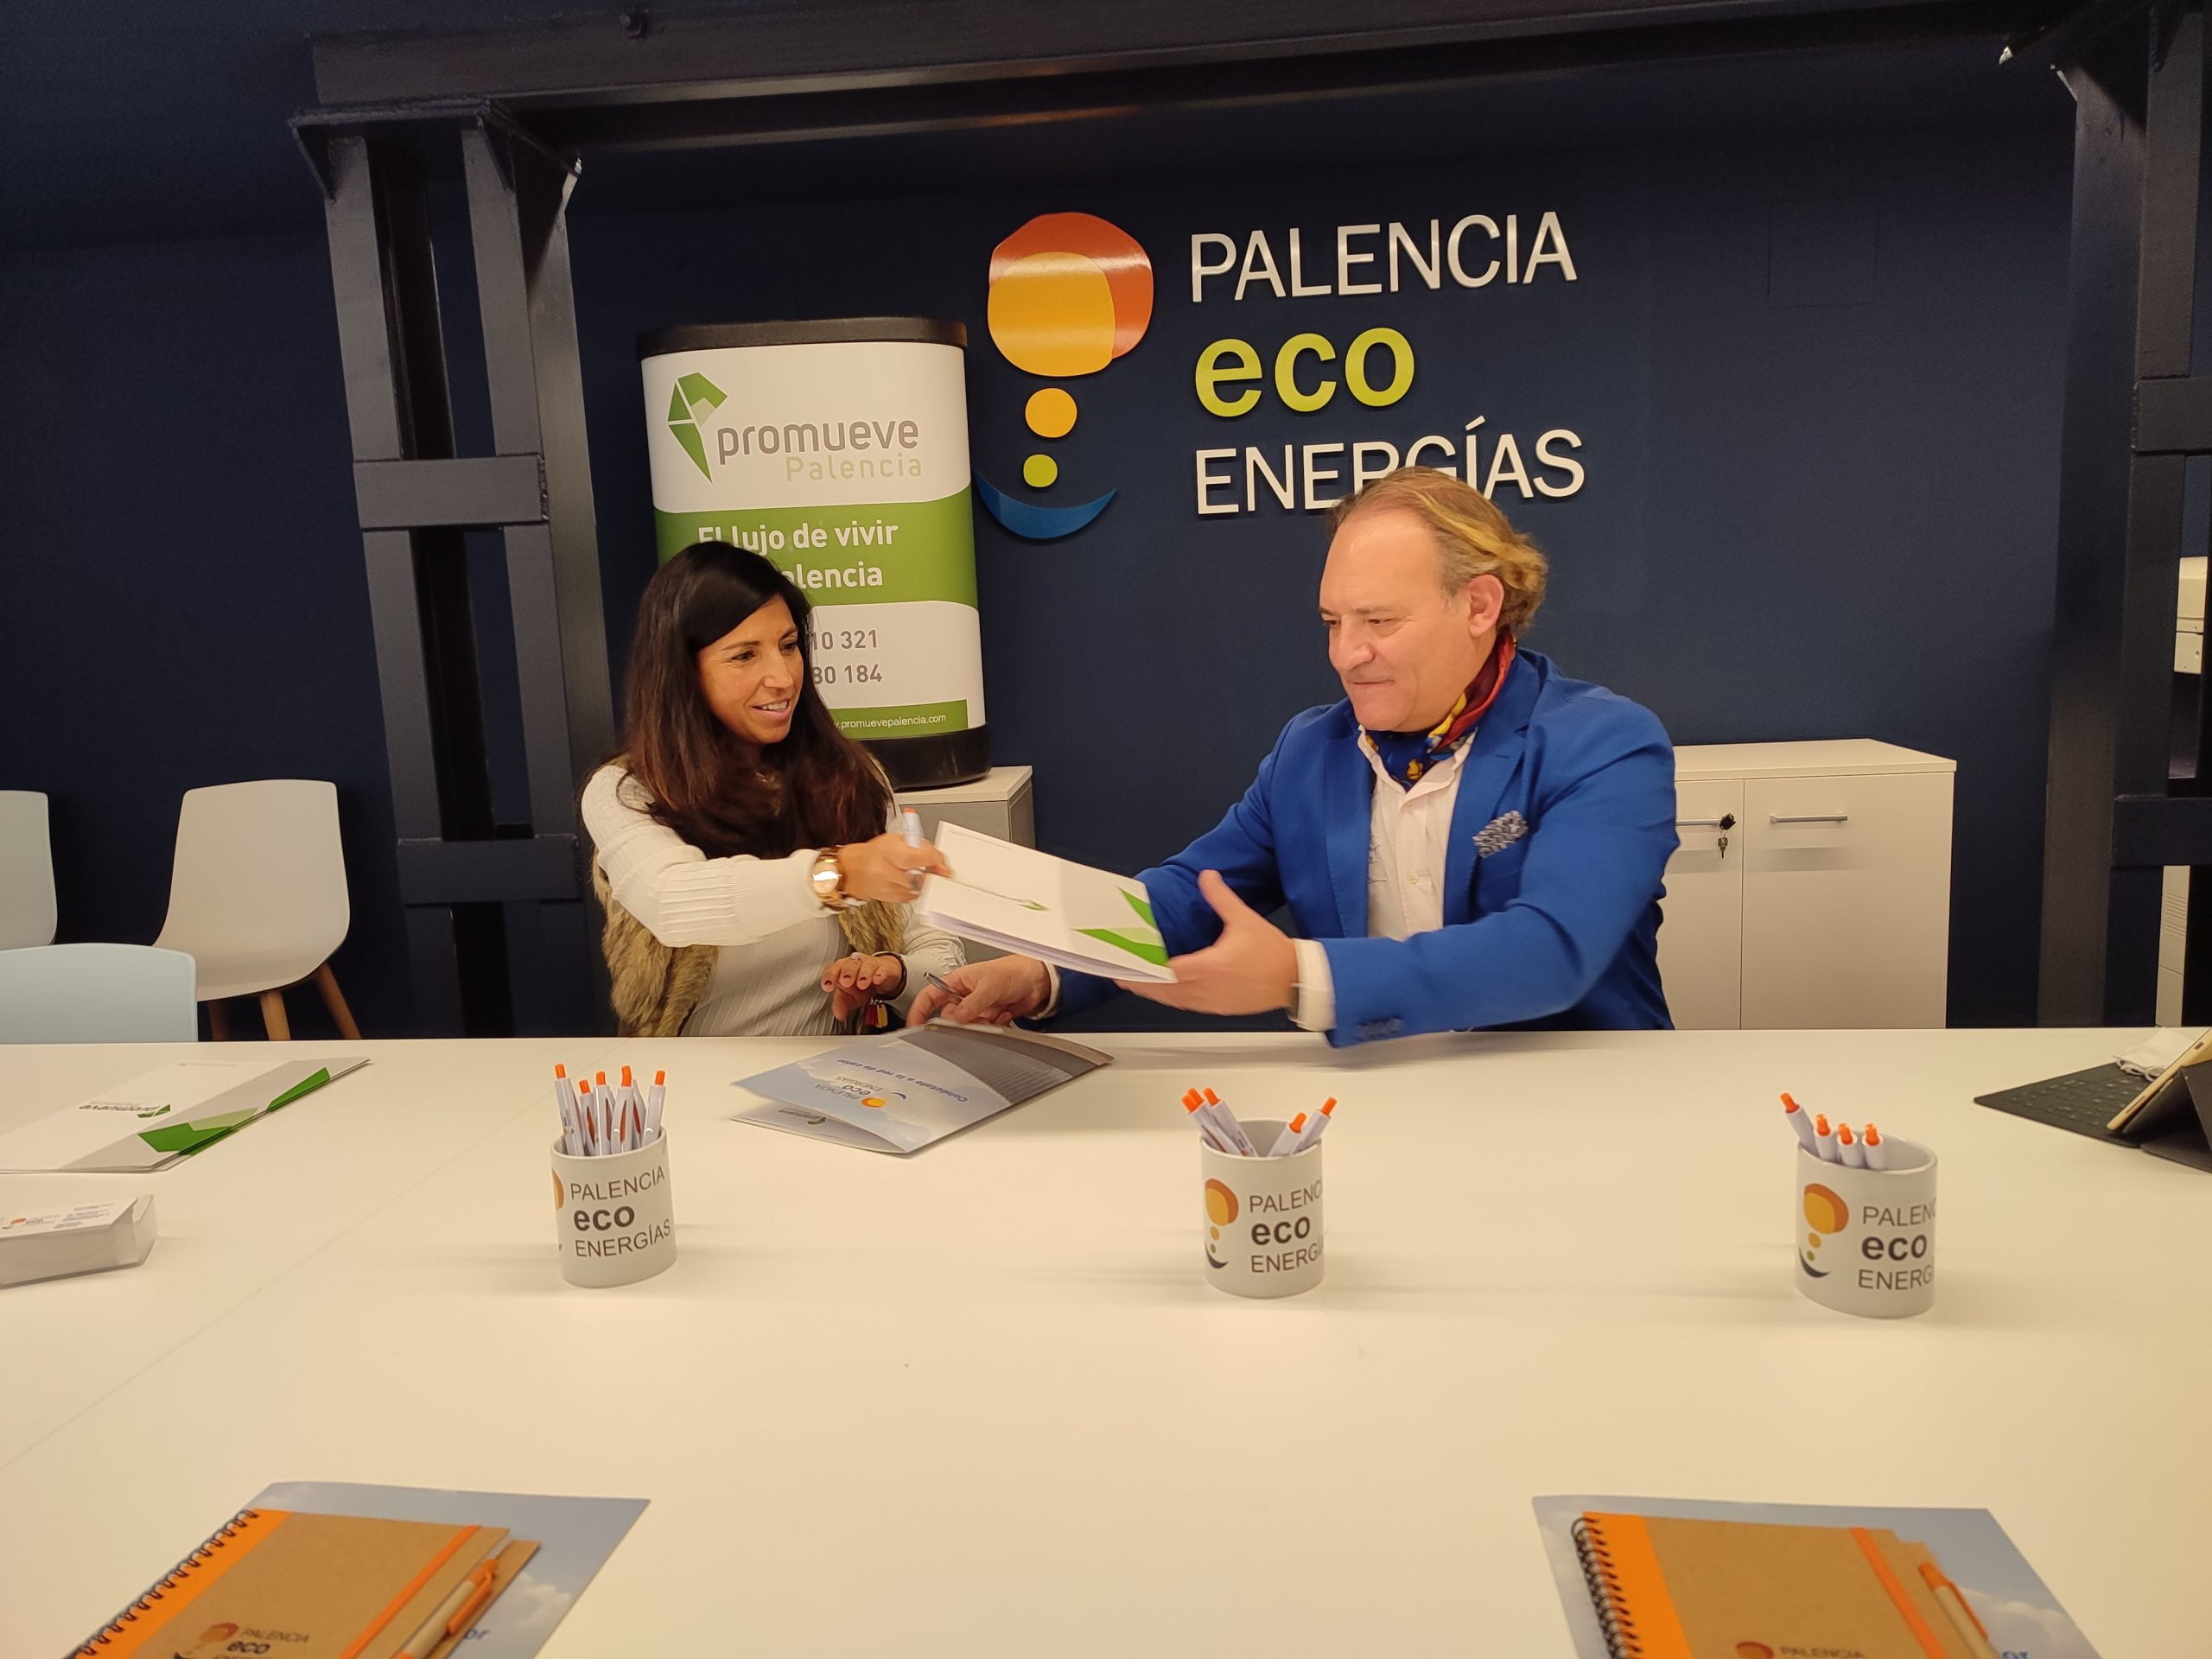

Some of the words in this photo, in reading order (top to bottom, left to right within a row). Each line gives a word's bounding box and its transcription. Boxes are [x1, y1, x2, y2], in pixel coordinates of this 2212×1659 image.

[1191, 211, 1578, 302] PALENCIA
[1194, 327, 1415, 417] eco
[717, 420, 918, 465] promueve
[785, 452, 922, 481] Palencia
[1195, 415, 1585, 515] ENERGÍAS
[732, 524, 785, 556] lujo
[792, 522, 828, 549] de
[834, 519, 899, 547] vivir
[781, 561, 883, 589] alencia
[840, 629, 877, 650] 321
[844, 664, 882, 683] 184
[570, 1165, 665, 1201] PALENCIA
[573, 1205, 635, 1231] eco
[1251, 1216, 1311, 1246] eco
[575, 1218, 671, 1258] ENERGÍAS
[1861, 1234, 1927, 1262] eco
